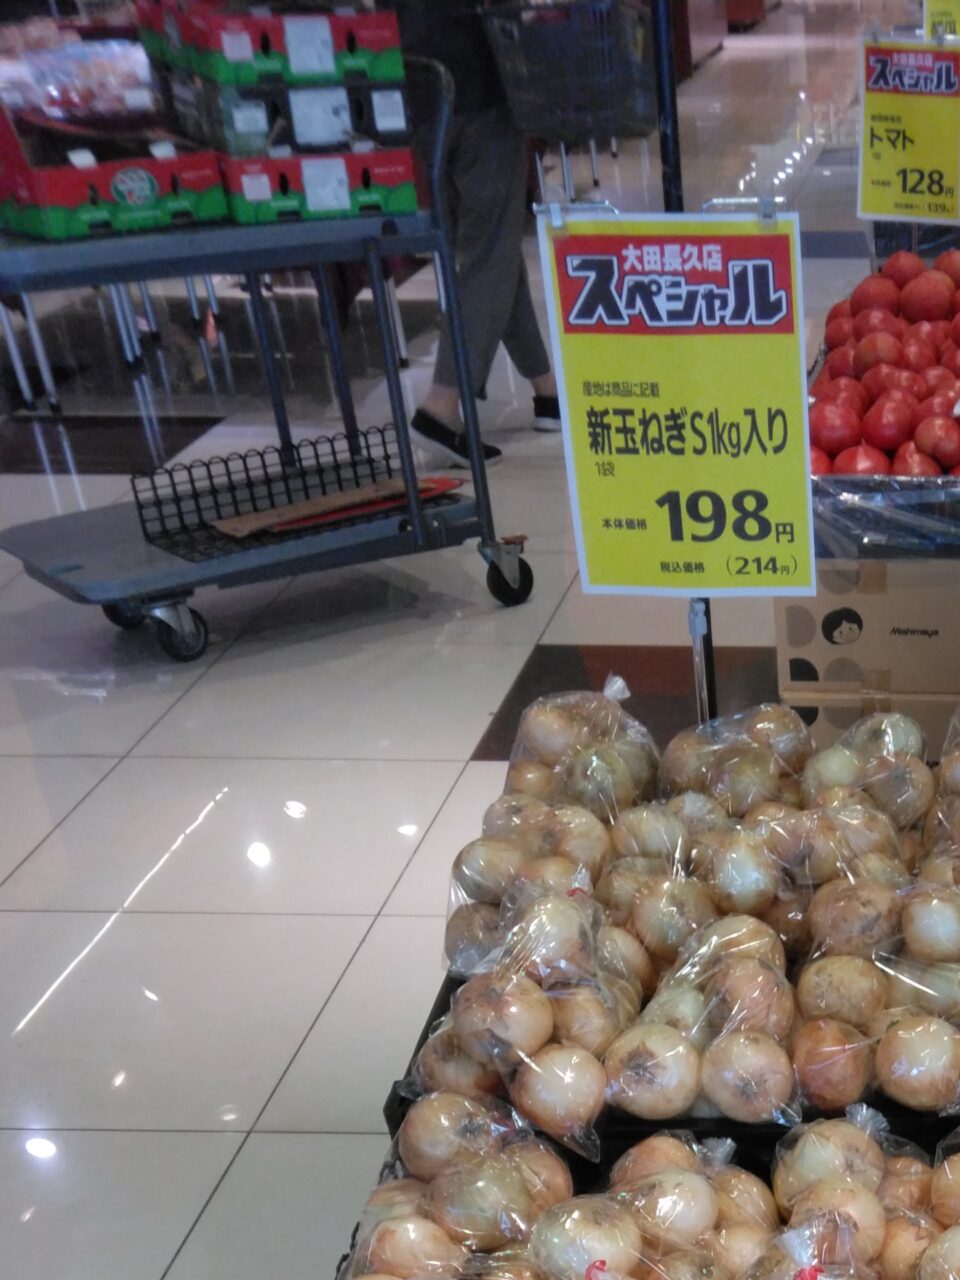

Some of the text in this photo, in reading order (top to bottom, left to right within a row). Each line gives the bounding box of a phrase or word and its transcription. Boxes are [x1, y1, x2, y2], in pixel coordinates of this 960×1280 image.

[869, 55, 959, 93] スペシャル
[869, 126, 915, 151] トマト
[622, 243, 722, 272] 大田長久店
[566, 254, 787, 327] スペシャル
[586, 406, 788, 458] 新玉ねぎS1kg入り
[602, 518, 647, 530] 本体価格
[660, 561, 705, 573] 税込価格
[889, 626, 939, 639] Mishimaya
